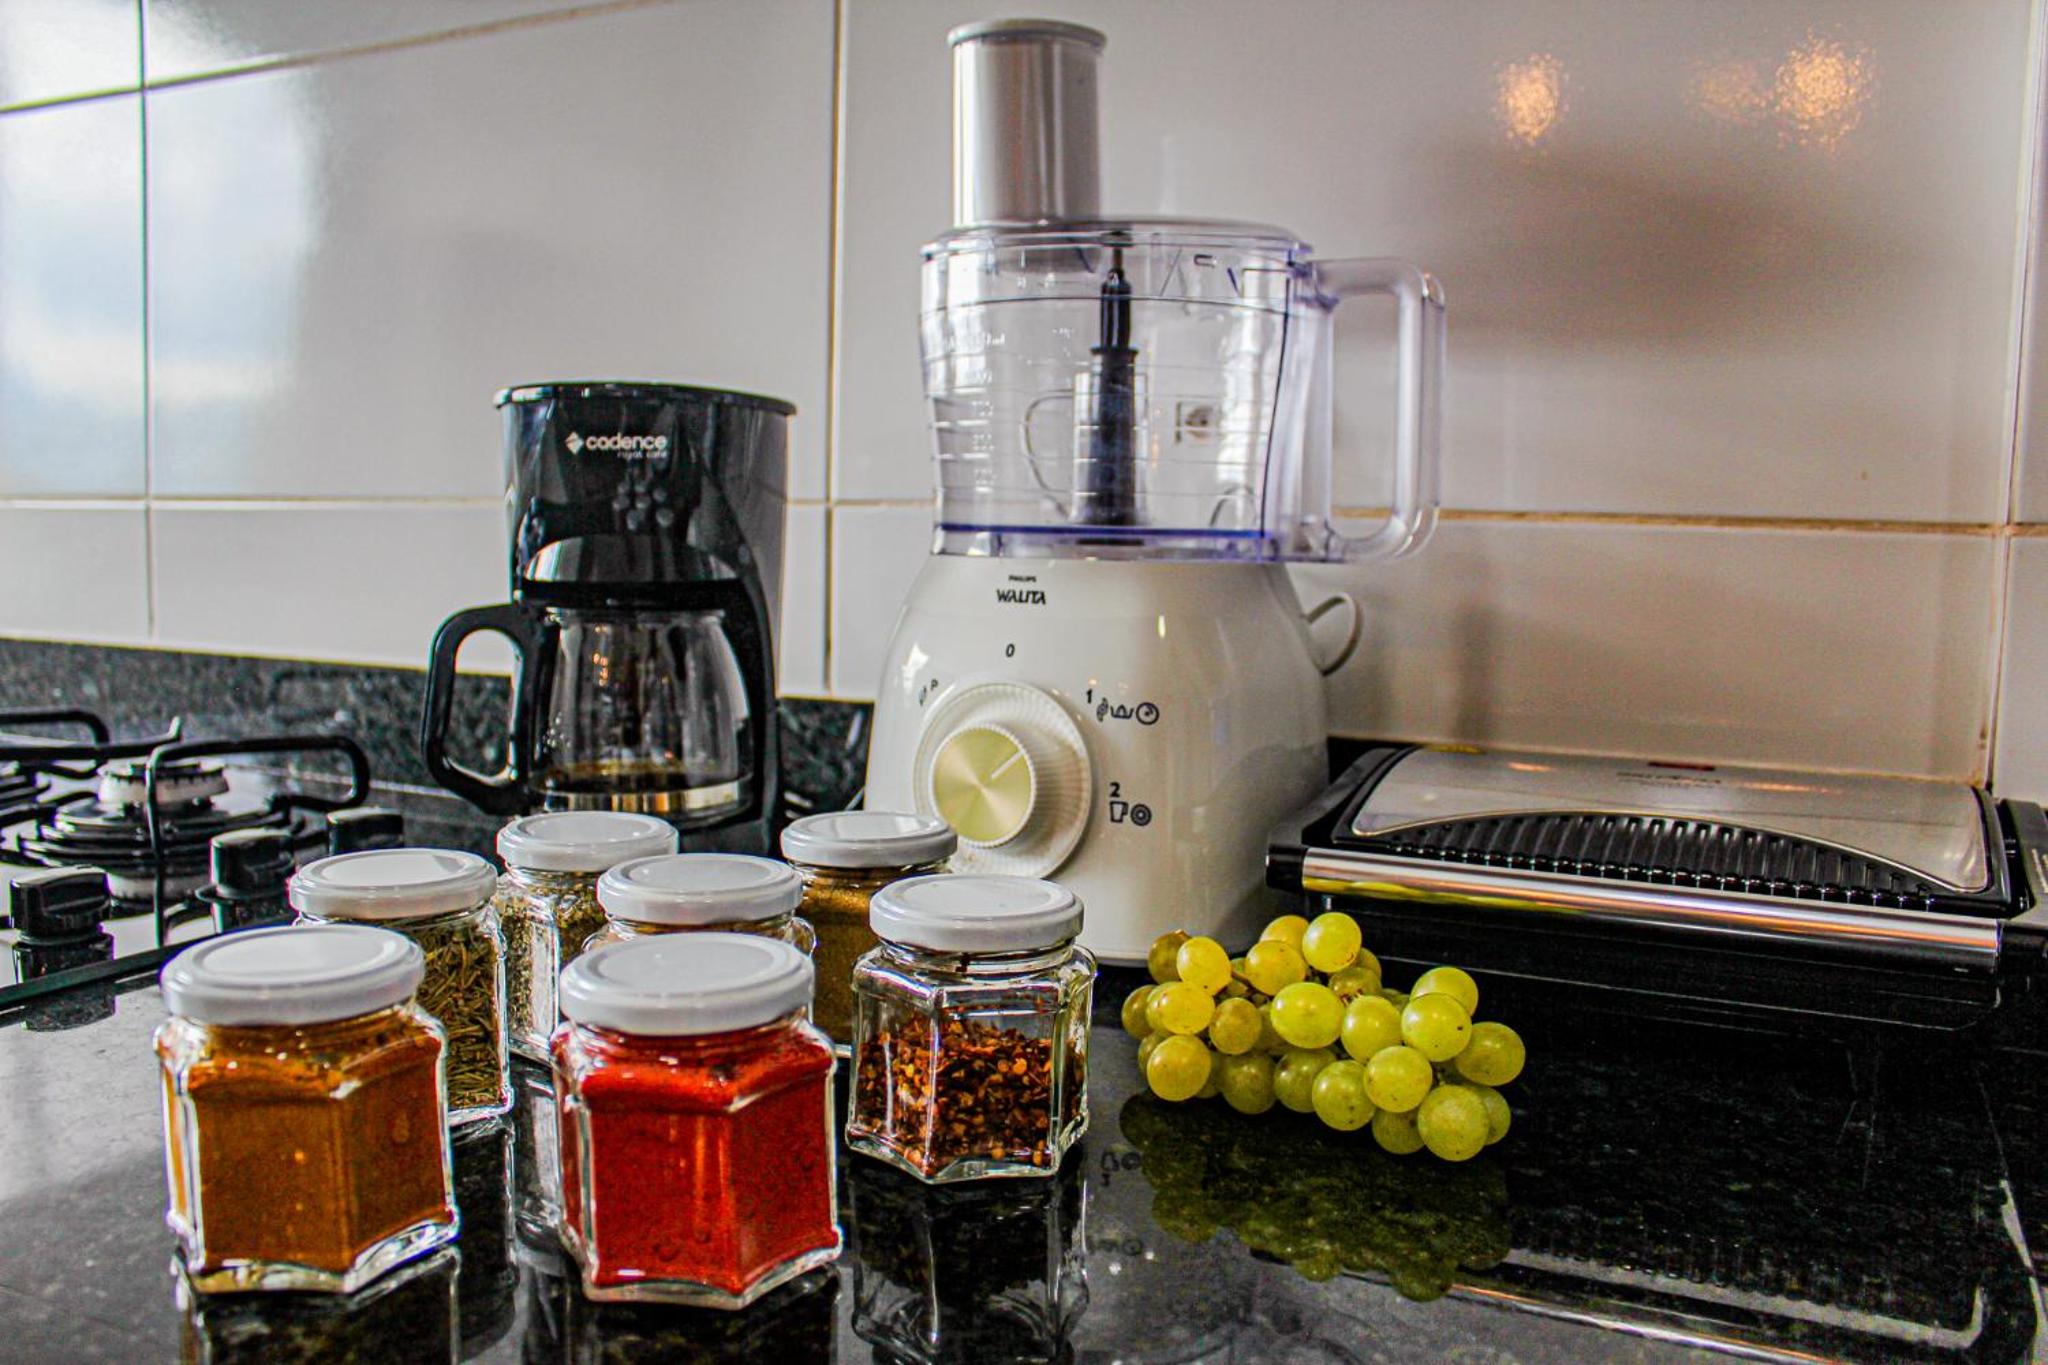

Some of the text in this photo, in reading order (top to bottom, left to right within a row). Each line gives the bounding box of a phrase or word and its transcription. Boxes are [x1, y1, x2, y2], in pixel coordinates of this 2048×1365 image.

[586, 432, 668, 450] cadence
[996, 589, 1046, 605] WALITA
[1086, 689, 1093, 703] 1
[1109, 782, 1120, 797] 2
